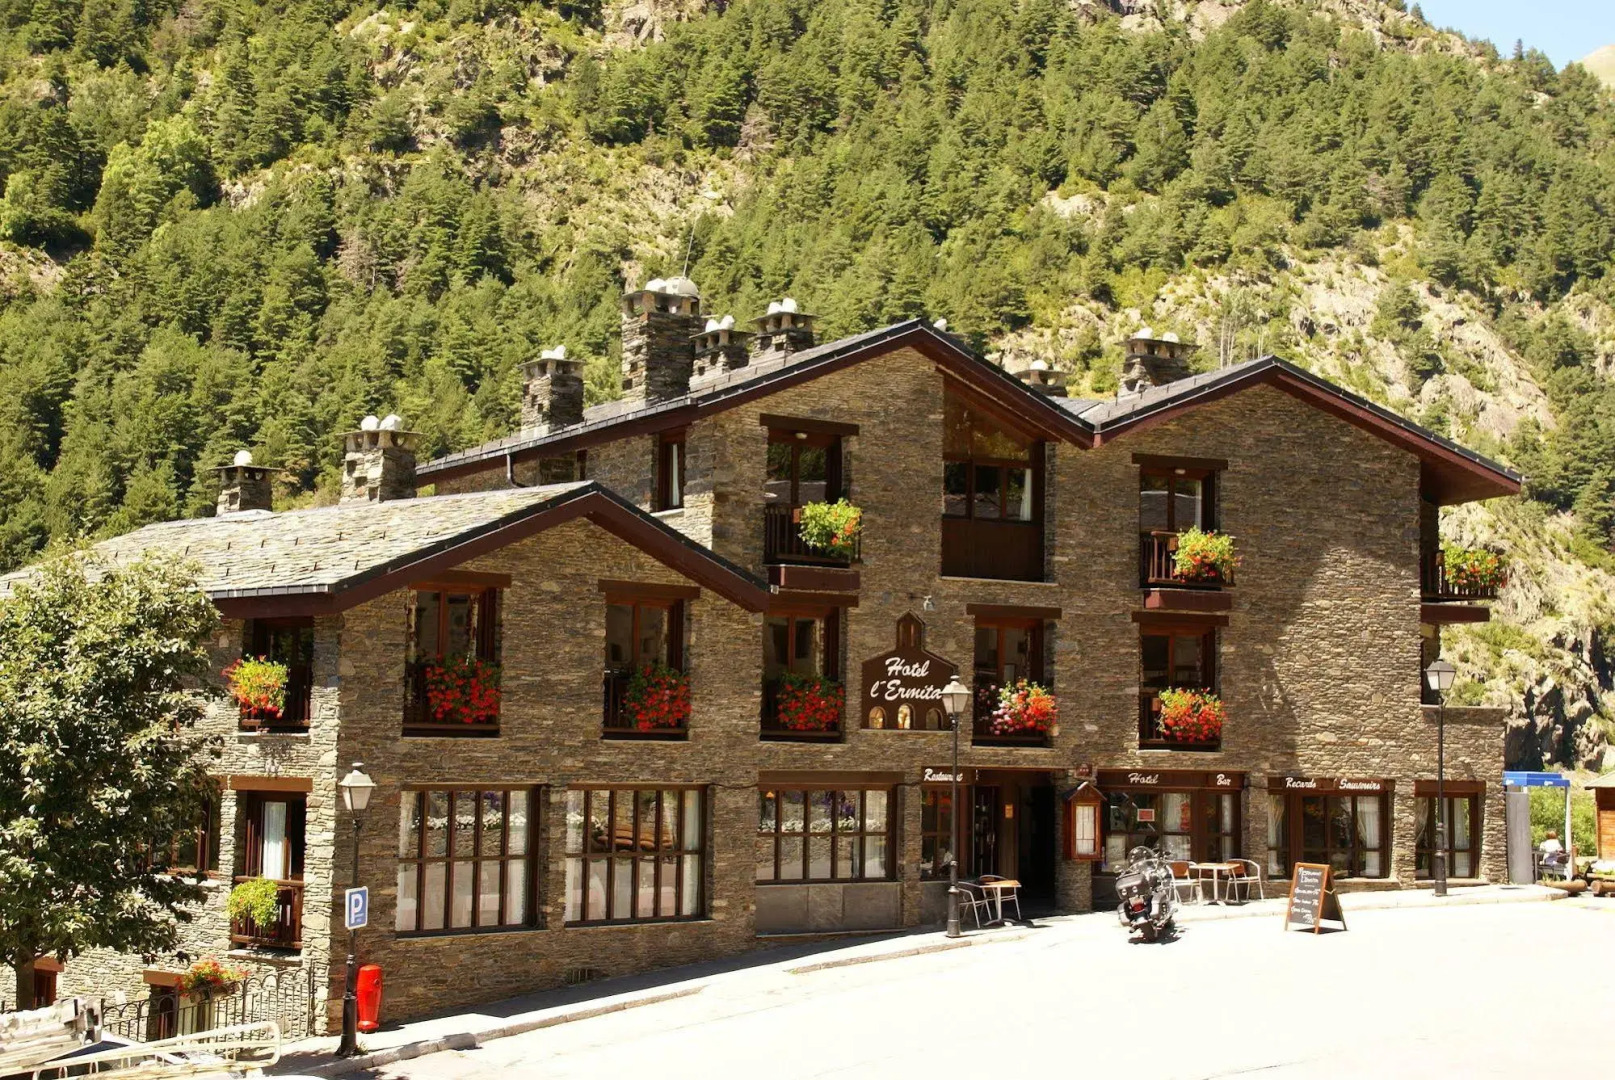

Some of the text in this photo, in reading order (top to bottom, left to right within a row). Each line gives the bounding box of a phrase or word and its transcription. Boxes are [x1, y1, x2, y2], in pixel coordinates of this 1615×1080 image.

[885, 657, 930, 677] Hotel
[1127, 772, 1159, 784] Hotel
[1216, 773, 1231, 786] Bar
[1339, 777, 1381, 790] Souvenirs
[351, 894, 363, 923] P
